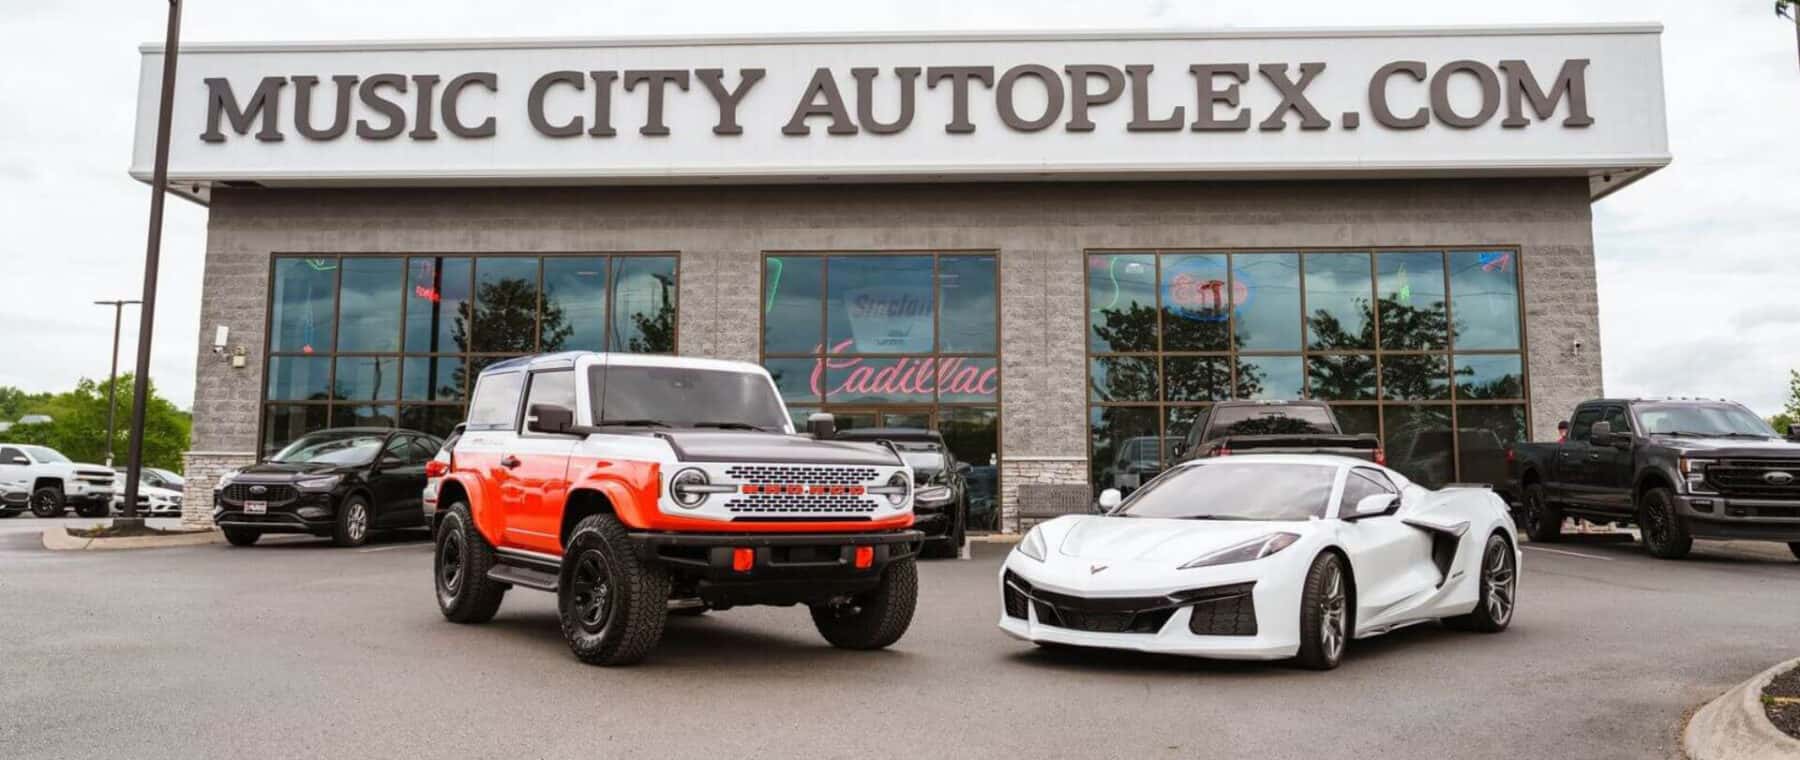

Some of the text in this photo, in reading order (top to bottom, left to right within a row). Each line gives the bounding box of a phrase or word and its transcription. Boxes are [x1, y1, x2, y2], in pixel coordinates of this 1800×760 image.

[200, 59, 1596, 144] MUSIC CITY AUTOPLEX.COM
[810, 339, 998, 399] Cadillac
